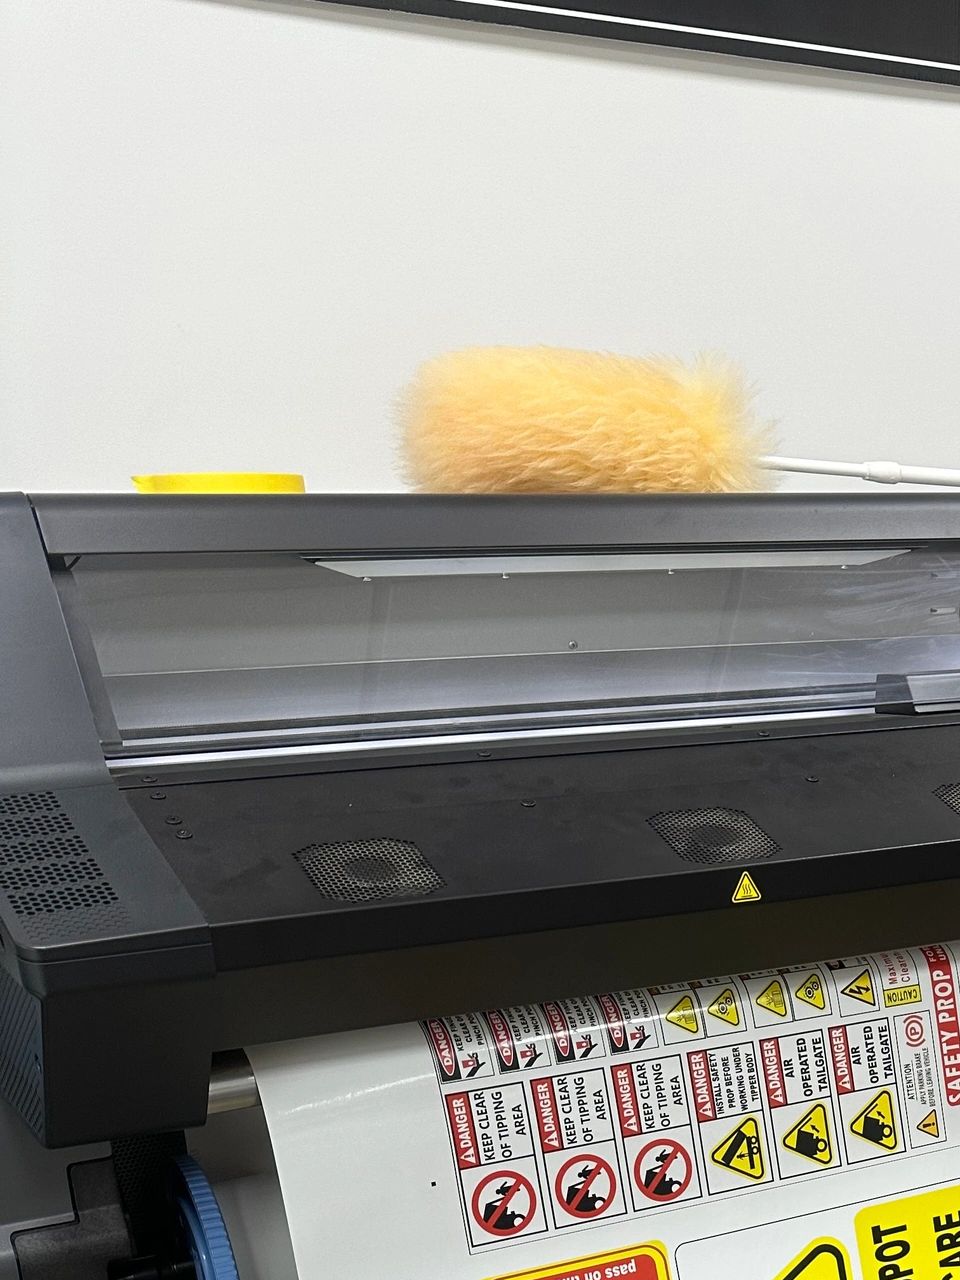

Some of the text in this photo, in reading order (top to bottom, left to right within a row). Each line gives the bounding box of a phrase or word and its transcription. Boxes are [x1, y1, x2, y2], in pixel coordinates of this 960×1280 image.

[887, 989, 917, 1002] CAUTION
[933, 969, 955, 1023] PROP
[434, 1020, 453, 1066] DANGER
[765, 1040, 781, 1088] DANGER
[797, 1038, 814, 1097] OPERATED
[812, 1037, 828, 1092] TAILGATE
[832, 1028, 851, 1076] DANGER
[852, 1046, 863, 1065] AIR
[863, 1025, 879, 1084] OPERATED
[878, 1025, 894, 1079] TAILGATE
[617, 1069, 634, 1116] DANGER
[670, 1076, 683, 1106] AREA
[691, 1053, 712, 1102] DANGER
[708, 1052, 724, 1115] INSTALL SAFETY
[721, 1056, 736, 1108] PROP BEFORE
[733, 1047, 748, 1111] WORKING UNDER
[745, 1052, 759, 1102] TIPPER BODY
[784, 1058, 795, 1078] AIR
[904, 1063, 914, 1100] ATTENTION
[512, 1104, 527, 1135] AREA
[537, 1082, 558, 1130] DANGER
[557, 1077, 578, 1144] KEEP CLEAR
[574, 1077, 593, 1142] OF TIPPING
[593, 1090, 606, 1120] AREA
[636, 1063, 655, 1129] KEEP CLEAR
[652, 1063, 670, 1127] OF TIPPING
[452, 1097, 473, 1146] DANGER
[474, 1091, 495, 1161] KEEP CLEAR
[492, 1092, 512, 1158] OF TIPPING
[605, 1259, 637, 1278] pass
